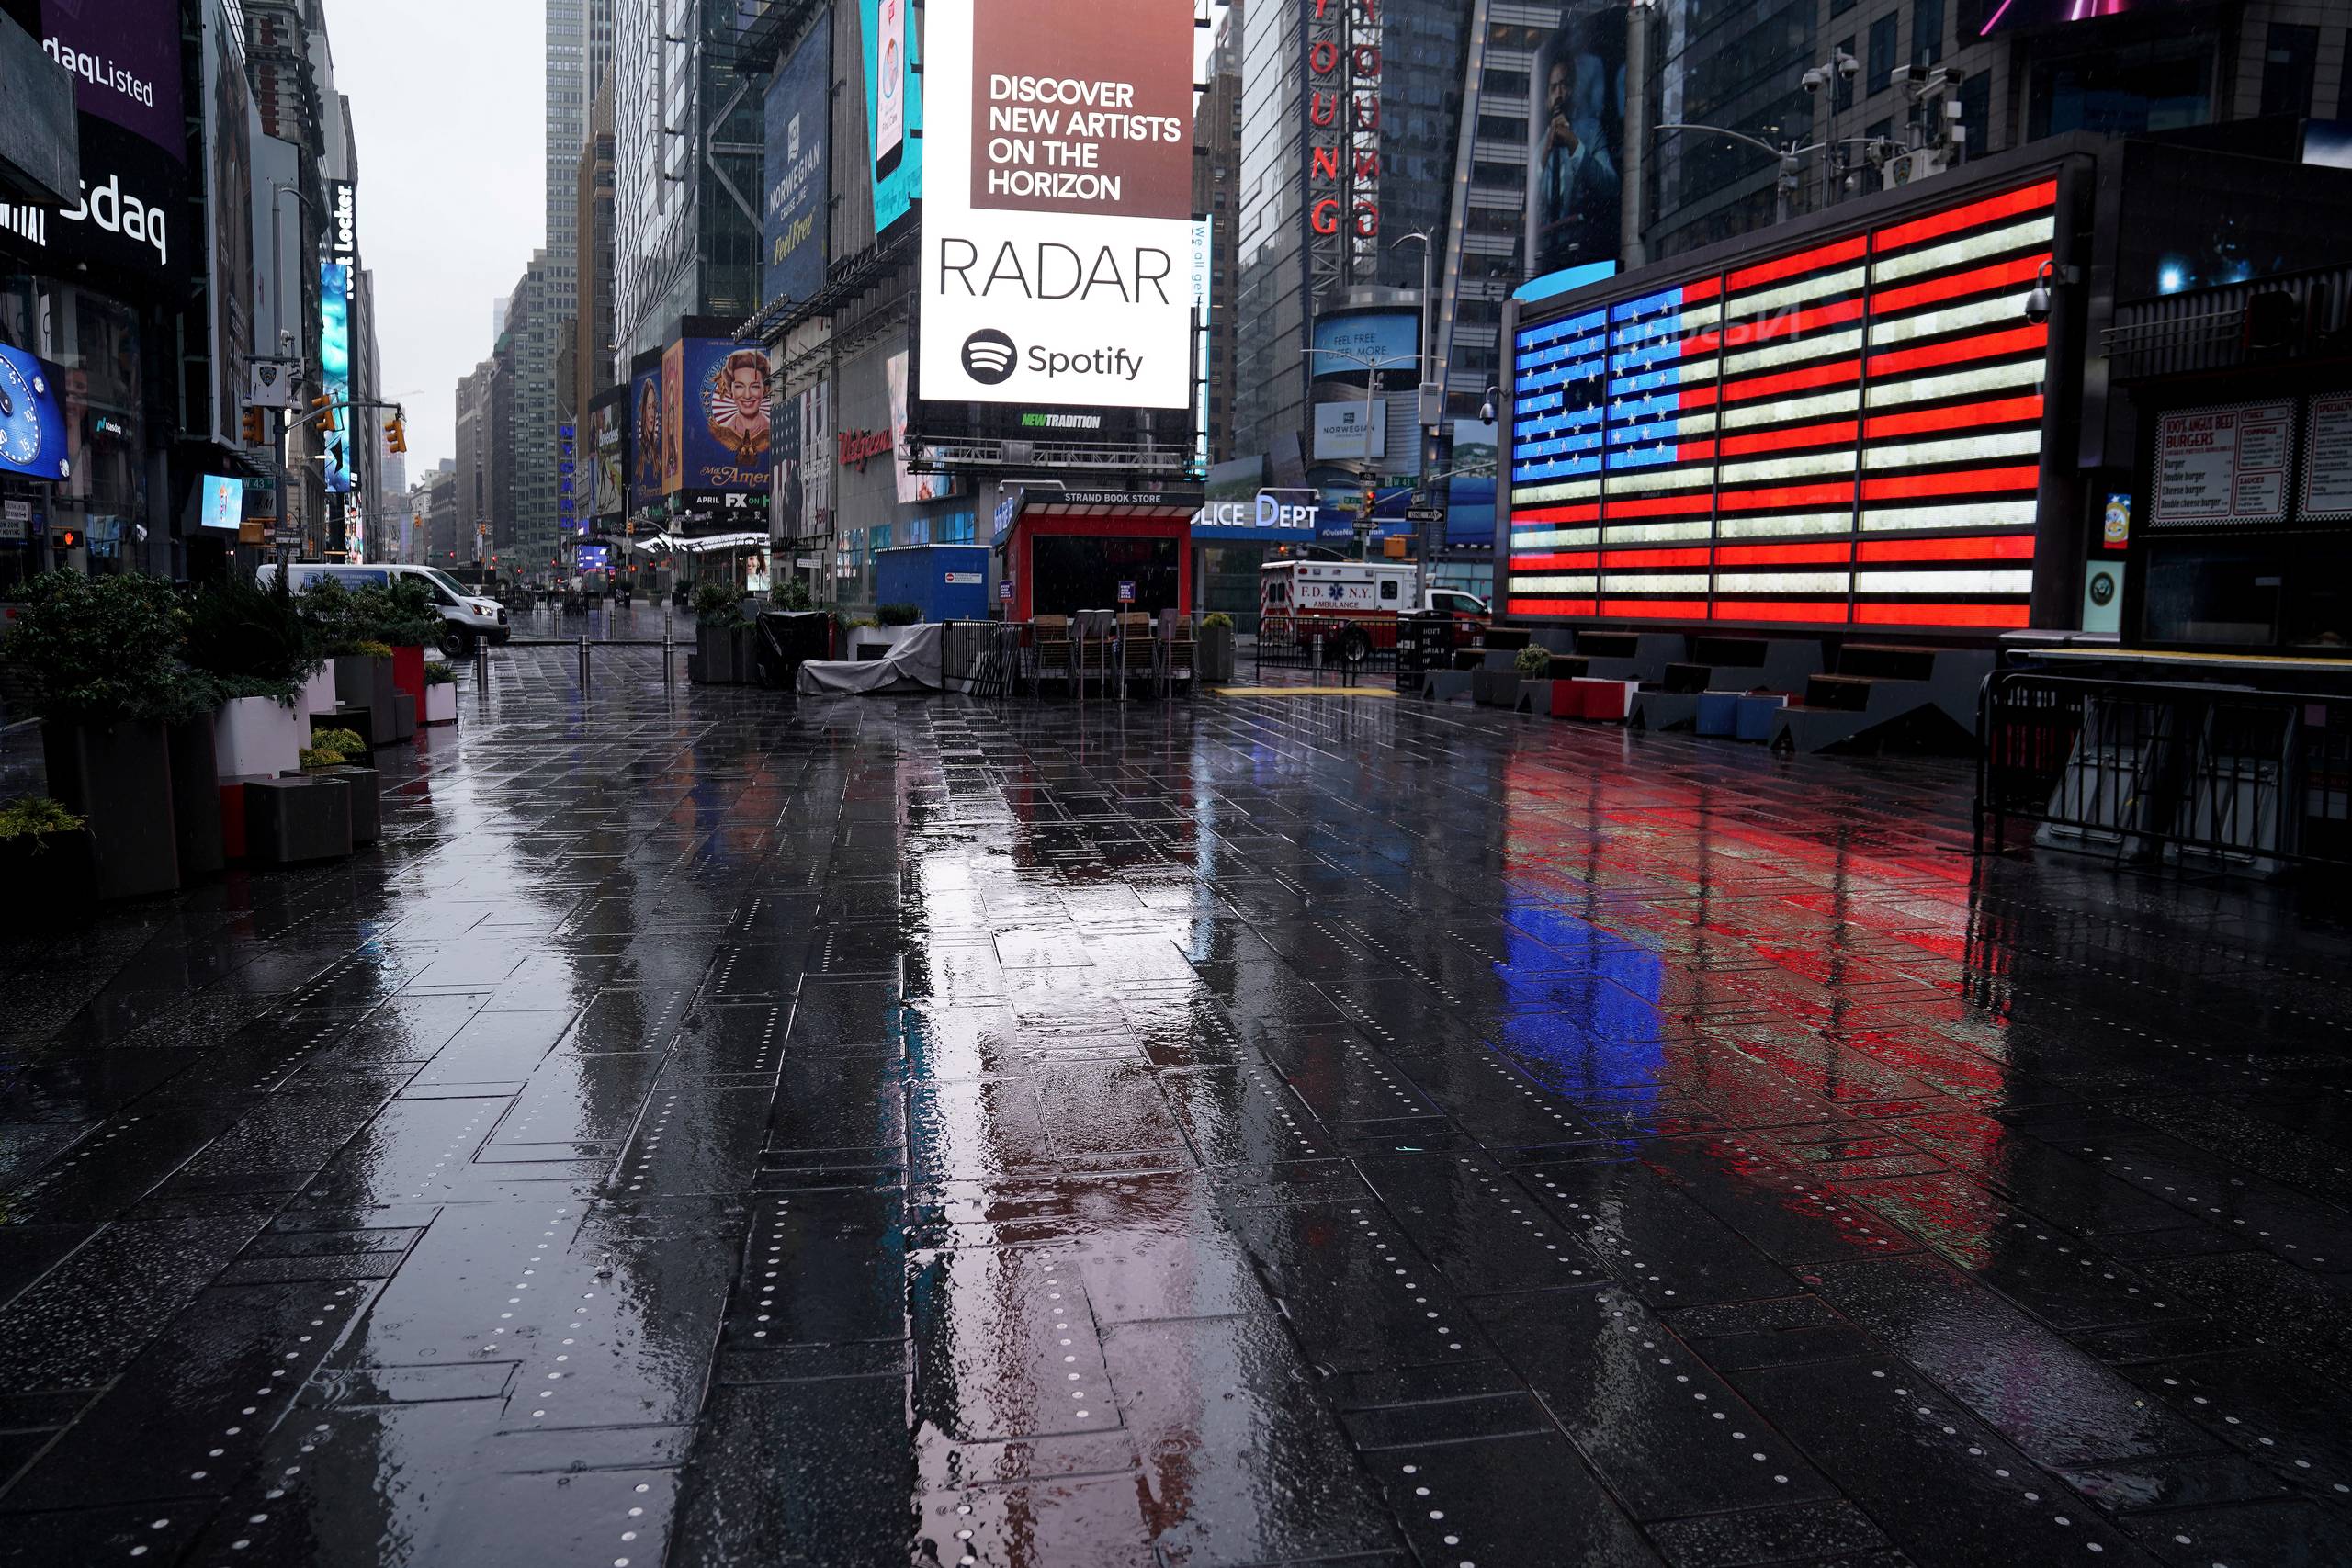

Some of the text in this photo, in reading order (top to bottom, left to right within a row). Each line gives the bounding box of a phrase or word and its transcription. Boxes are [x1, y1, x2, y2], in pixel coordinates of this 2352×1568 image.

[990, 74, 1134, 108] DISCOVER
[989, 107, 1182, 143] NEW ARTISTS
[988, 138, 1098, 168] ON THE
[769, 139, 820, 215] NORWEGIAN
[988, 169, 1121, 201] HORIZON
[780, 185, 808, 221] CRUISE LINE
[334, 185, 354, 251] Locker
[774, 213, 813, 266] Feel Free
[941, 237, 1170, 305] RADAR
[1194, 253, 1204, 268] all
[1334, 333, 1375, 345] FEEL FREE
[1027, 344, 1143, 380] Spotify
[24, 409, 34, 423] 10
[2166, 414, 2234, 434] 100% ANGUS BEEF
[20, 438, 30, 452] 15
[599, 425, 618, 447] breeders
[2166, 433, 2213, 448] BURGERS
[2165, 460, 2185, 470] Burger
[243, 479, 250, 489] W
[253, 479, 265, 489] 43
[1393, 478, 1400, 486] W
[696, 496, 720, 504] APRIL
[726, 493, 747, 508] FX
[749, 497, 760, 505] ON
[1065, 492, 1161, 504] STRAND BOOK STORE
[1255, 494, 1320, 528] DEPT
[1301, 586, 1372, 598] F.D. N.Y.
